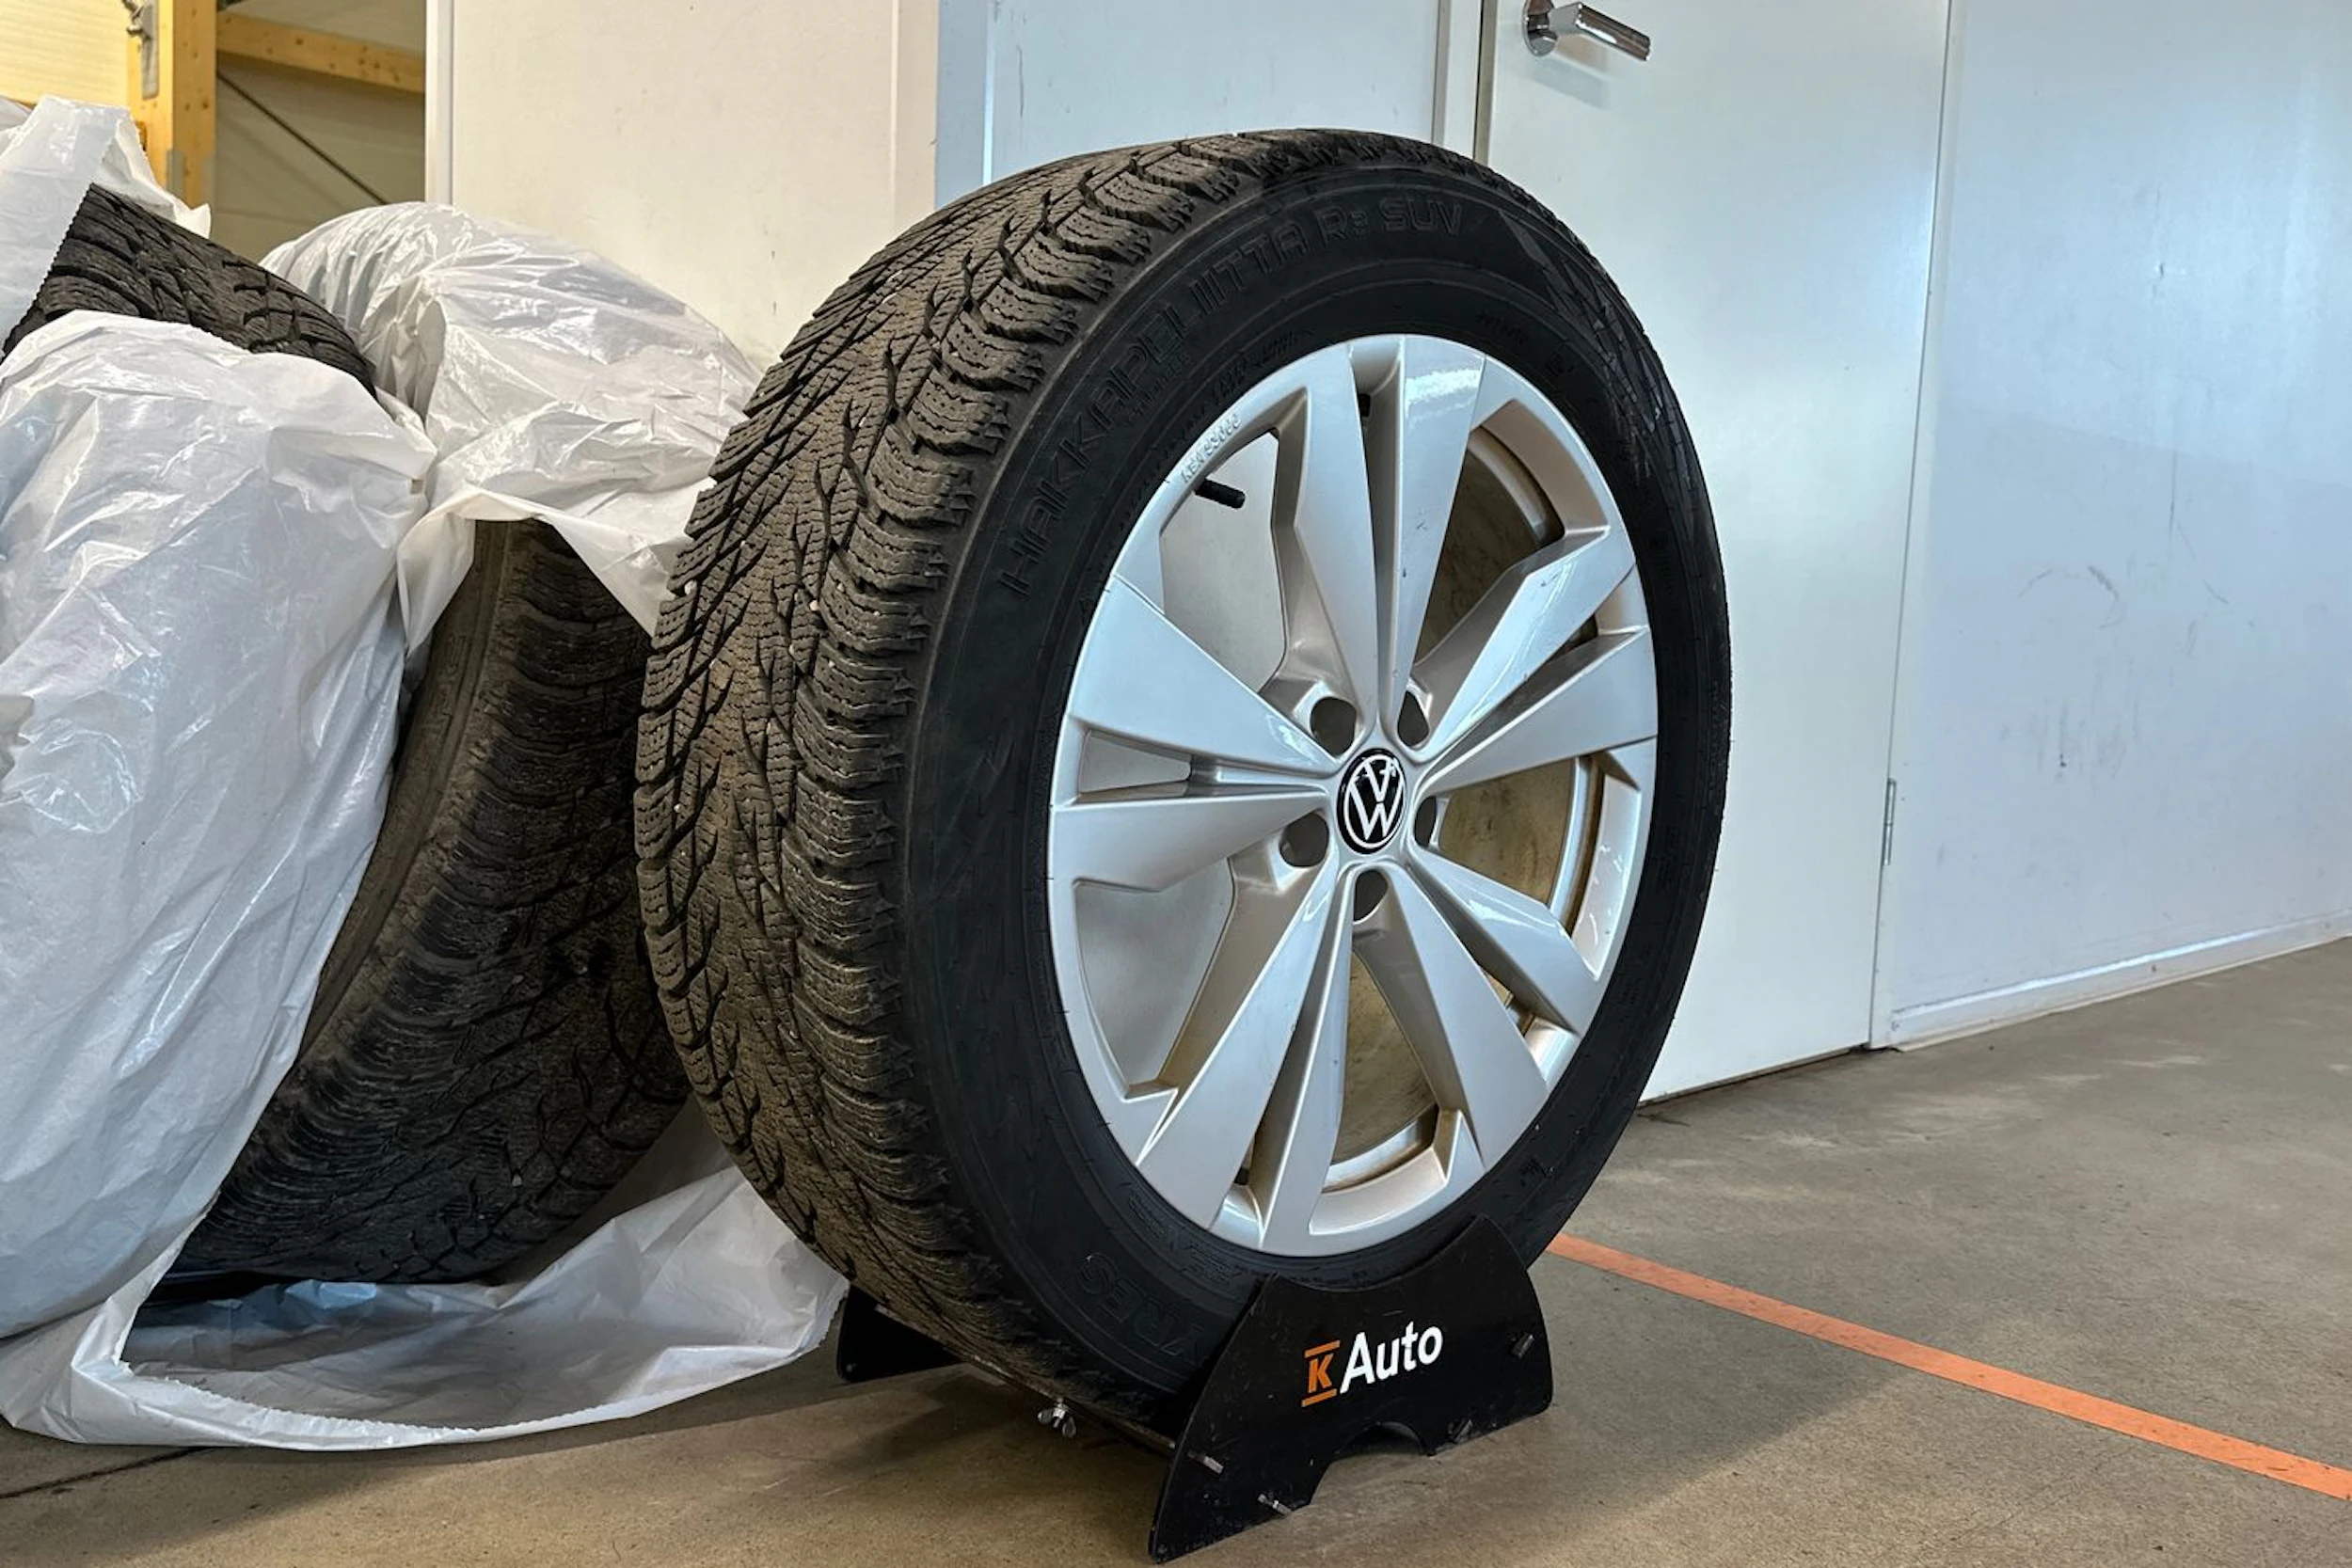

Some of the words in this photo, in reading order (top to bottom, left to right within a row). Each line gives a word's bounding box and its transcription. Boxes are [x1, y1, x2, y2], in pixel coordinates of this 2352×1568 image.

[1377, 196, 1462, 239] SUV
[1347, 756, 1403, 841] VW
[1340, 1321, 1443, 1394] Auto
